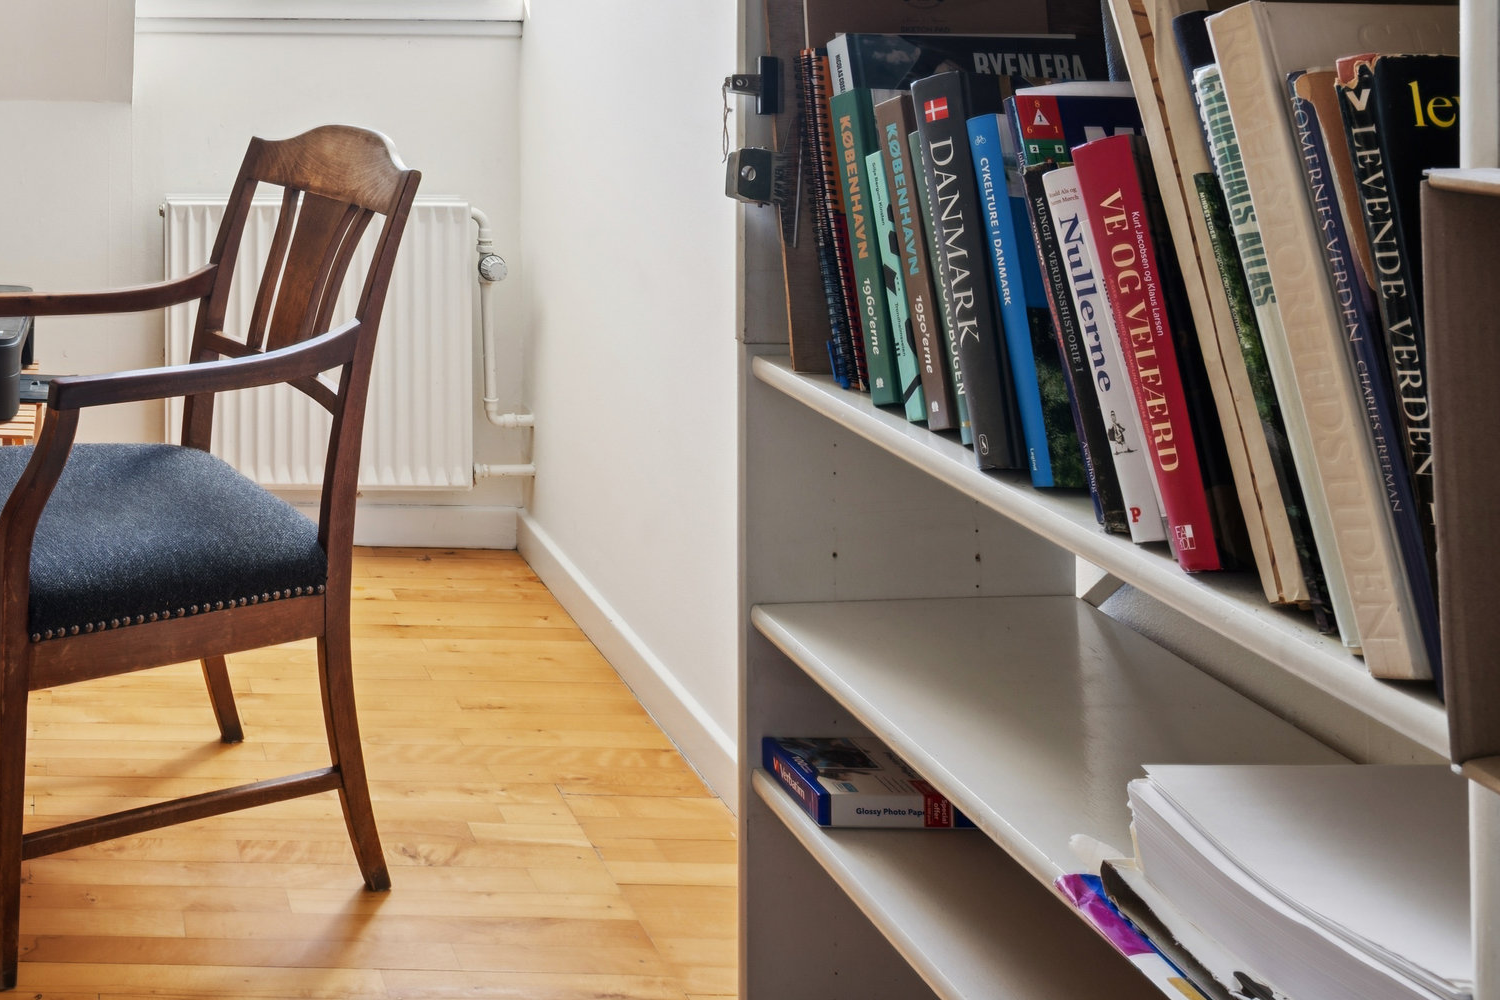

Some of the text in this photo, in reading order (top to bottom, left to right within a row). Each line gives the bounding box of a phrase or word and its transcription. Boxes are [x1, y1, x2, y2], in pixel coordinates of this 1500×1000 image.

[1026, 125, 1033, 134] 6
[1034, 99, 1041, 108] 8
[838, 115, 880, 356] KØBENHAVN 1960'erne
[885, 121, 934, 375] KØBENHAVN 1950'erne
[929, 136, 980, 349] DANMARK
[980, 157, 1012, 307] CYKELTURE DANMARK
[1100, 187, 1127, 236] VE
[1111, 242, 1142, 295] OG
[1131, 210, 1164, 336] Kurt Jacobsen og Klaus Larsen
[1196, 191, 1219, 239] MINDESTEDER
[1035, 197, 1051, 243] MUNCH
[1049, 249, 1081, 363] VERDENSHISTORIE
[1060, 213, 1111, 394] Nullerne
[1290, 96, 1403, 513] ROMERNES VERDEN CHARLES FREEMAN
[1351, 122, 1435, 477] LEVENDE VERDEN
[1125, 302, 1179, 473] VELFÆRD
[1129, 506, 1141, 523] P
[779, 763, 807, 800] Verbatim
[855, 807, 882, 818] Glossy
[883, 807, 907, 817] Photo
[941, 798, 949, 826] Special
